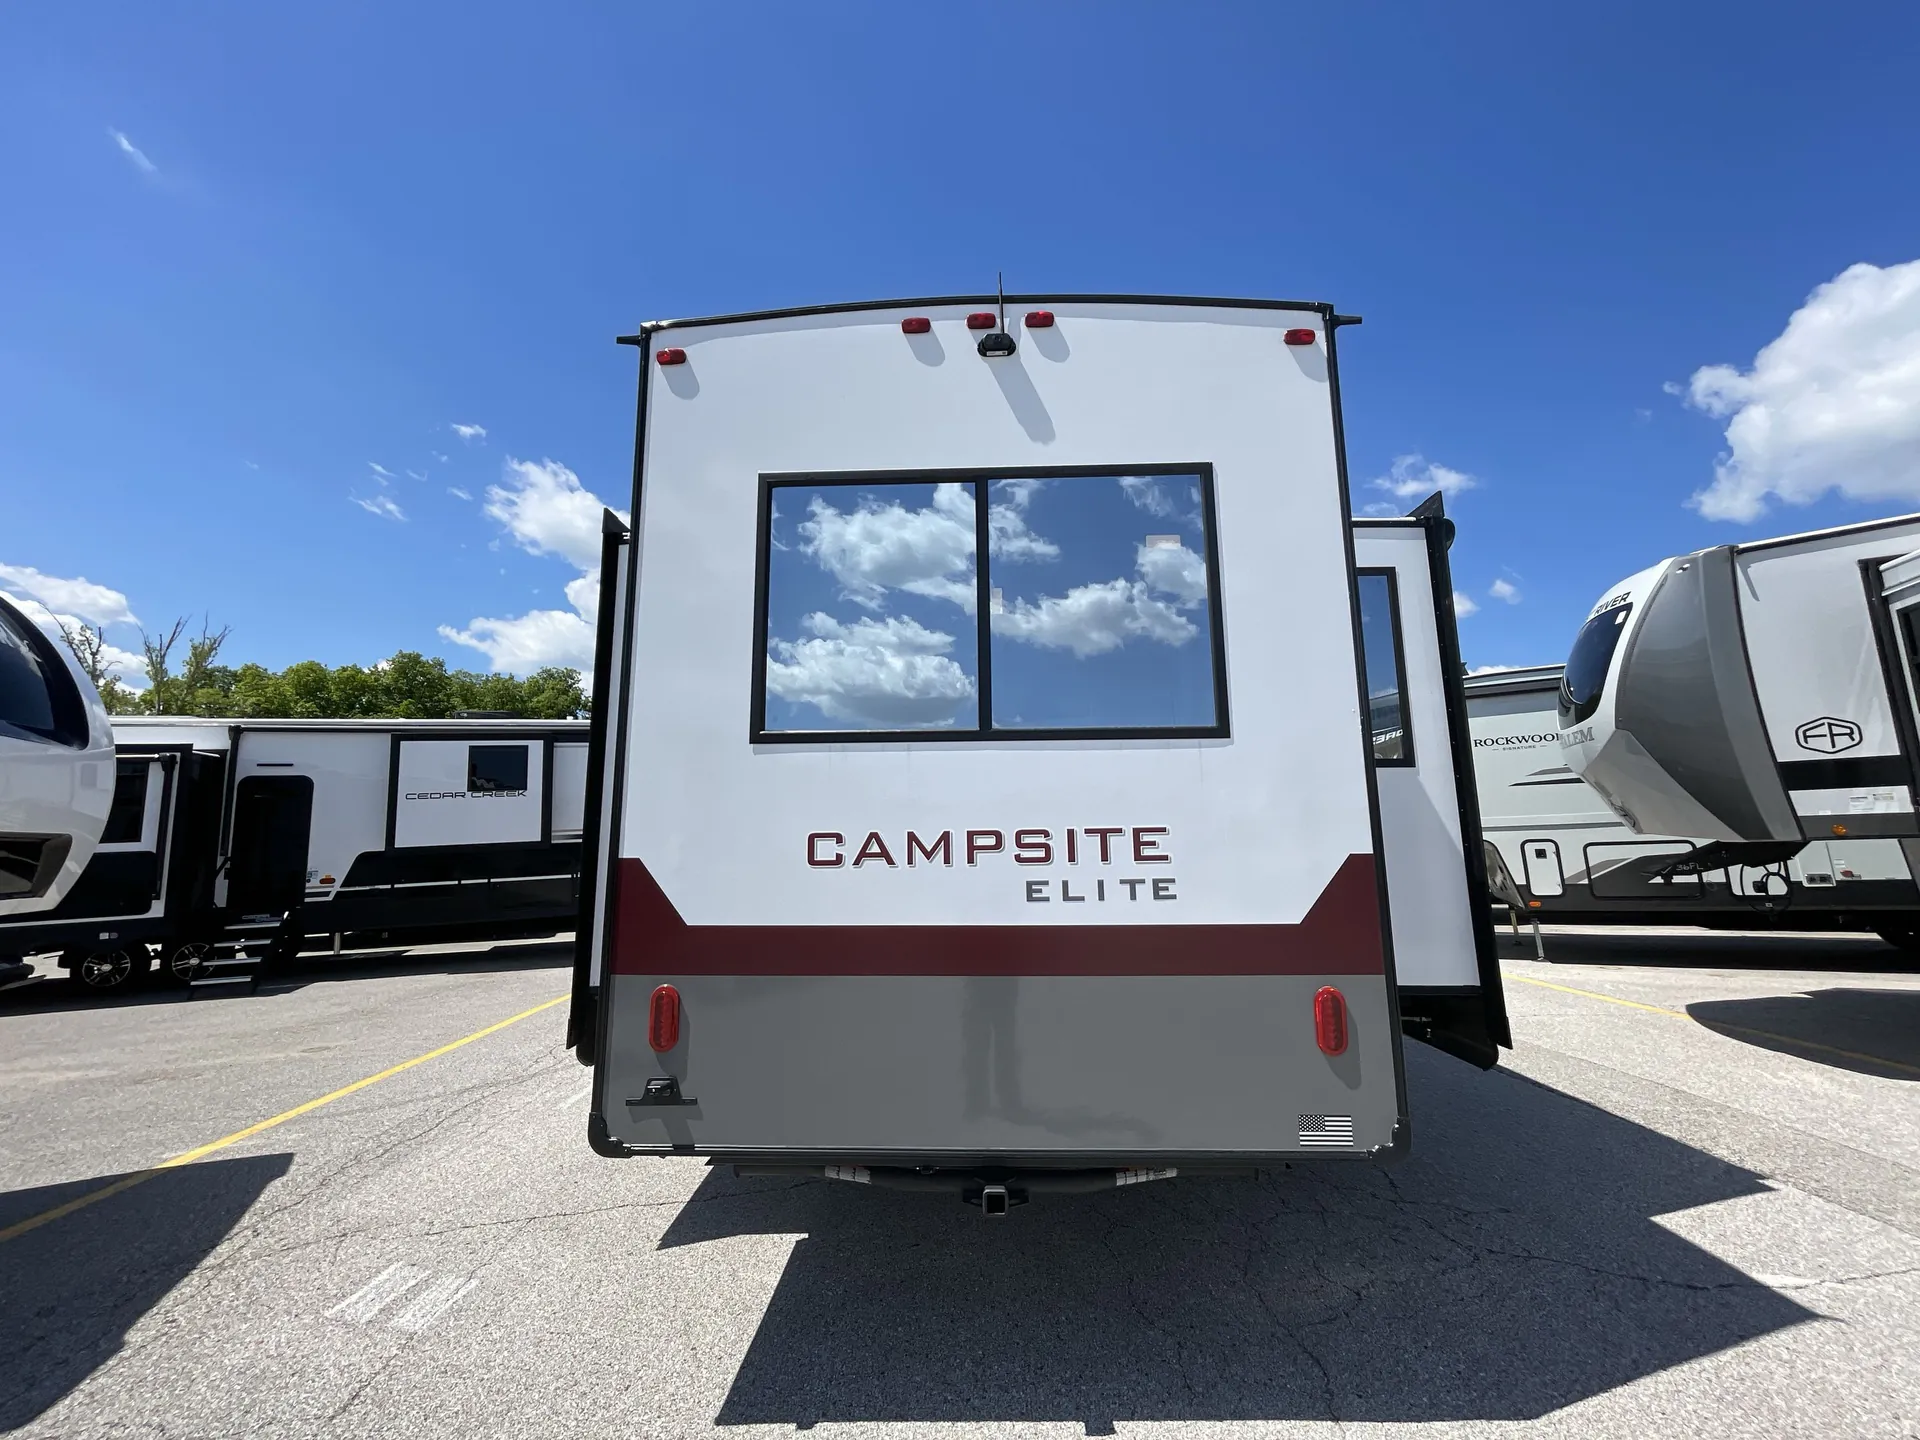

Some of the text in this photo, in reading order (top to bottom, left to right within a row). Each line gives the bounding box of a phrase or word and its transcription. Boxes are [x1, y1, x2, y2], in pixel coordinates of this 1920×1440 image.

[1594, 591, 1632, 616] RIVER
[1802, 722, 1855, 749] FR
[405, 790, 527, 800] CEDAR CREEK
[806, 826, 1172, 867] CAMPSITE
[1026, 878, 1177, 902] ELITE
